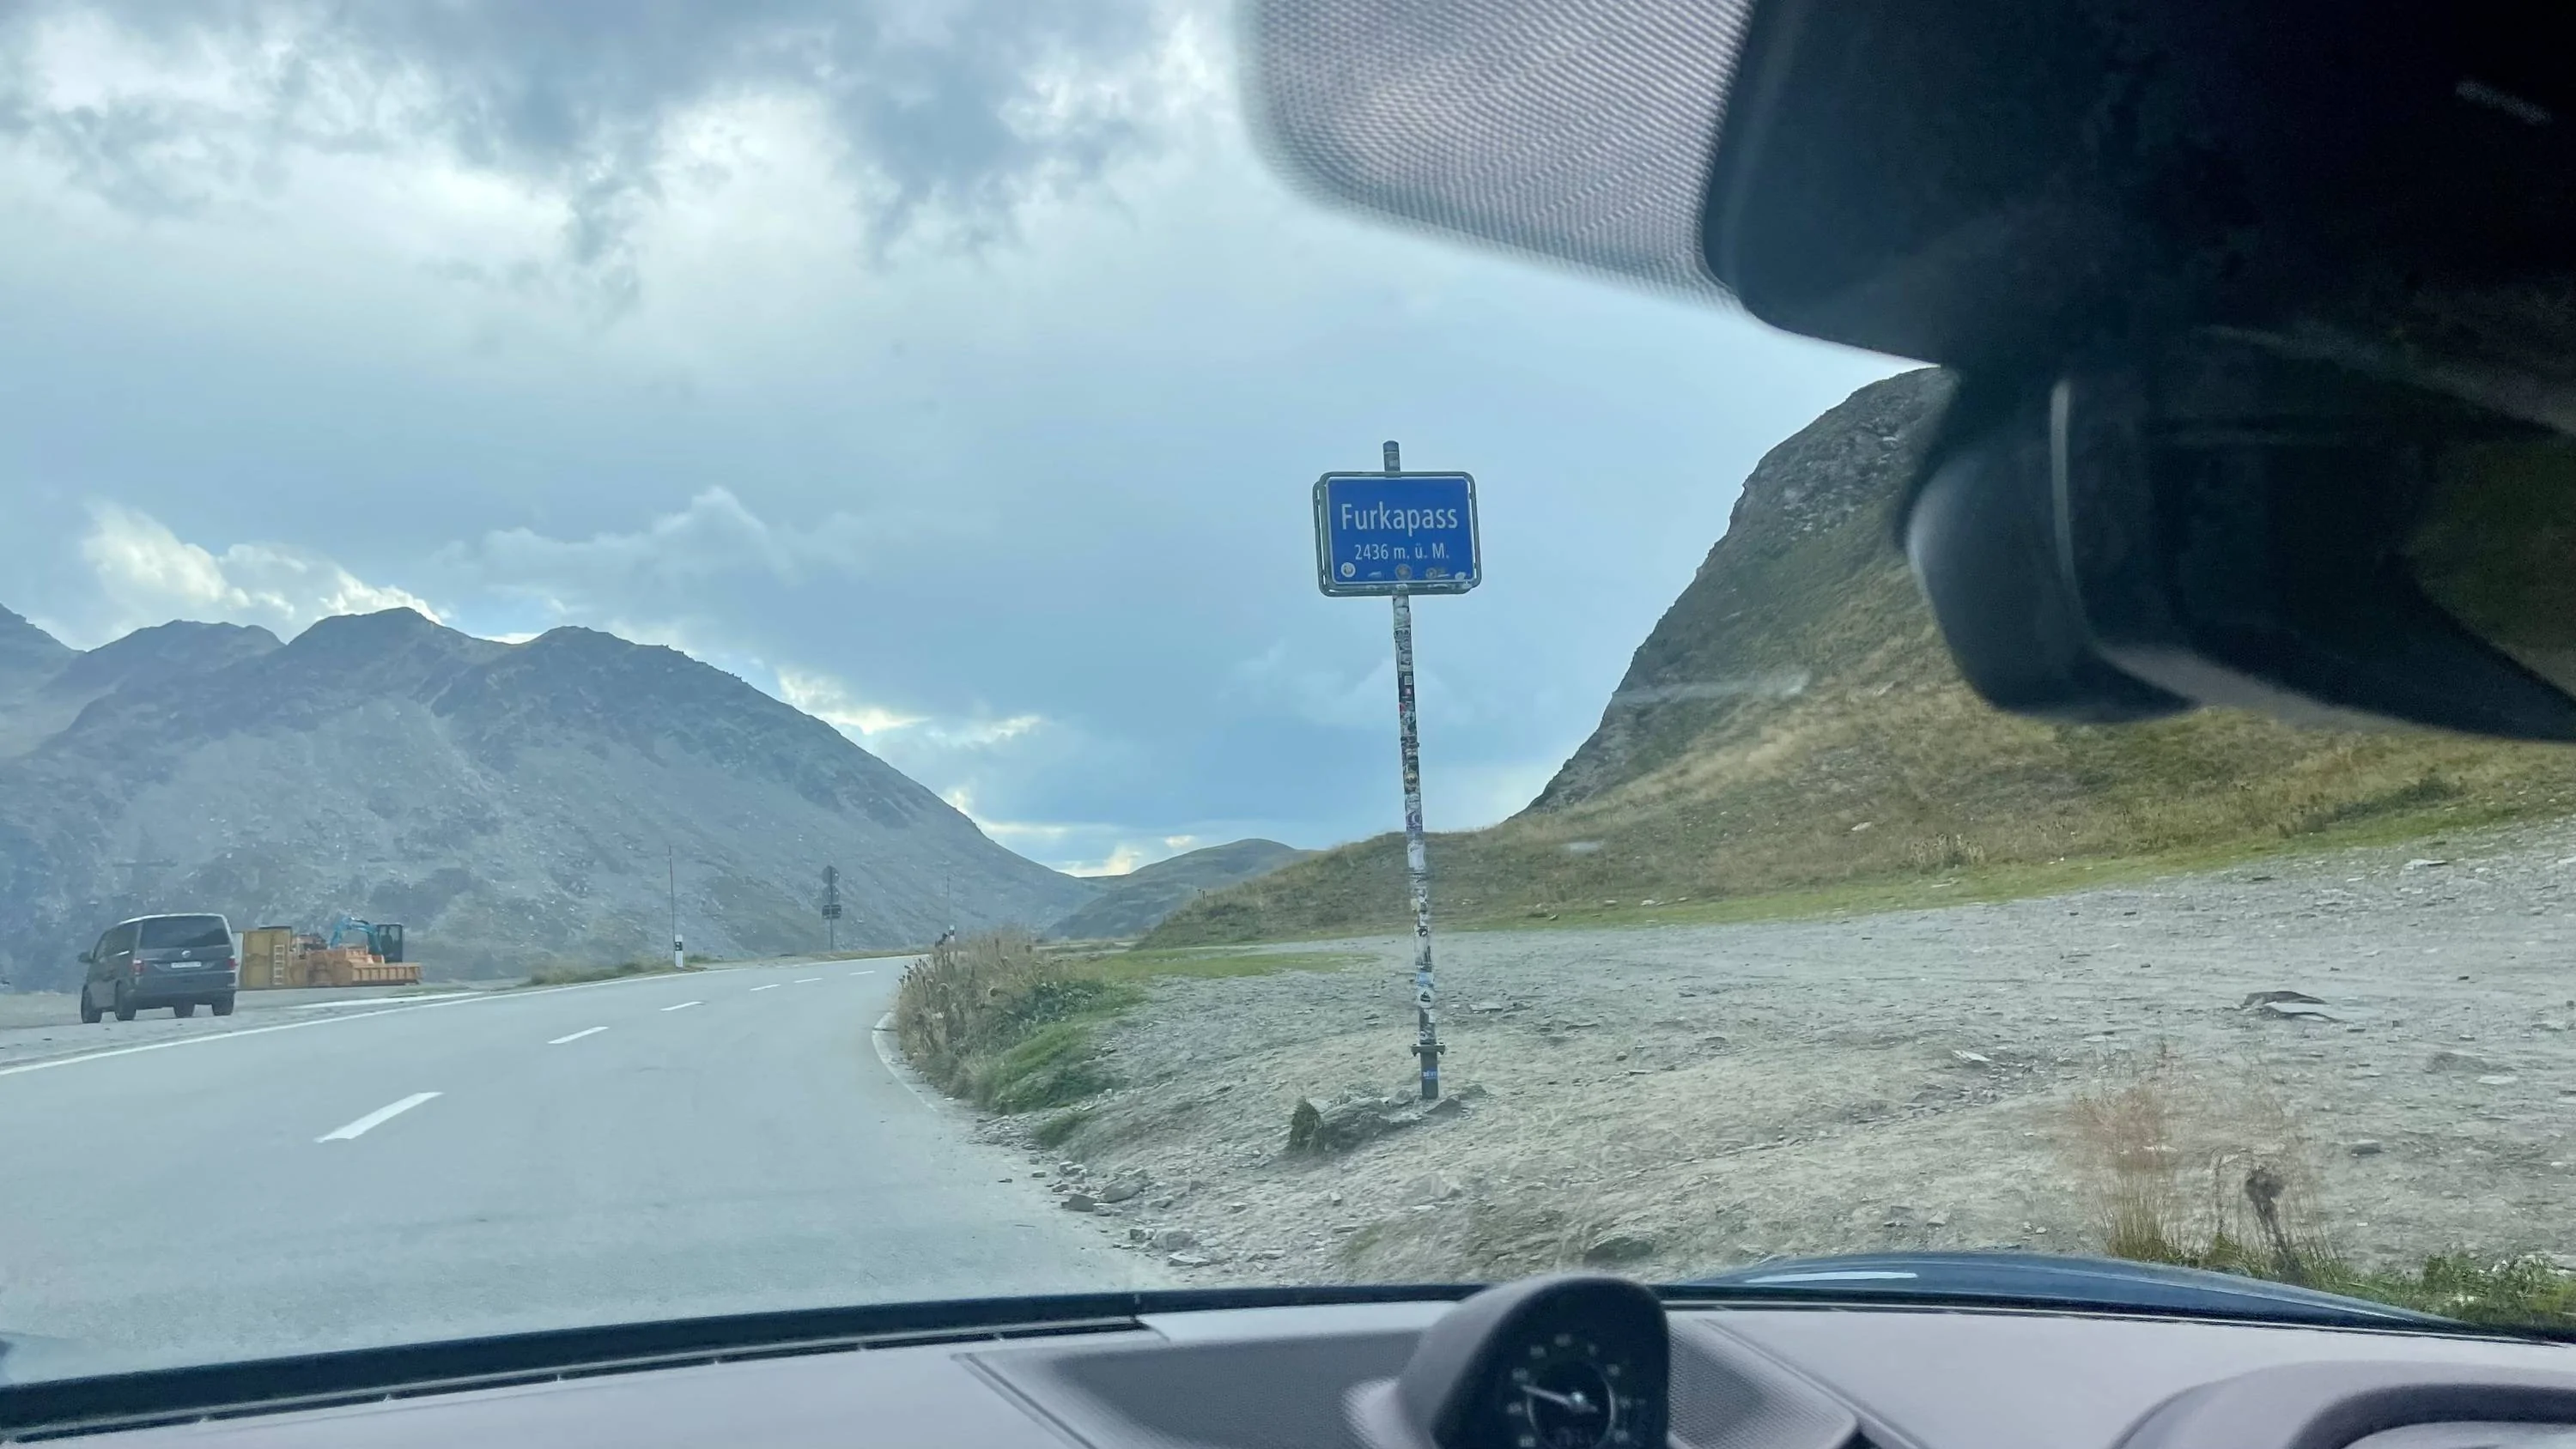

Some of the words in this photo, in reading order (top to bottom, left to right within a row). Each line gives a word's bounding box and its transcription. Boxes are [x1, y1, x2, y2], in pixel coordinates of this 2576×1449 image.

[1340, 500, 1458, 537] Furkapass
[1354, 543, 1389, 561] 2436
[1394, 547, 1410, 561] m.
[1415, 543, 1428, 560] ü.
[1431, 542, 1449, 560] M.
